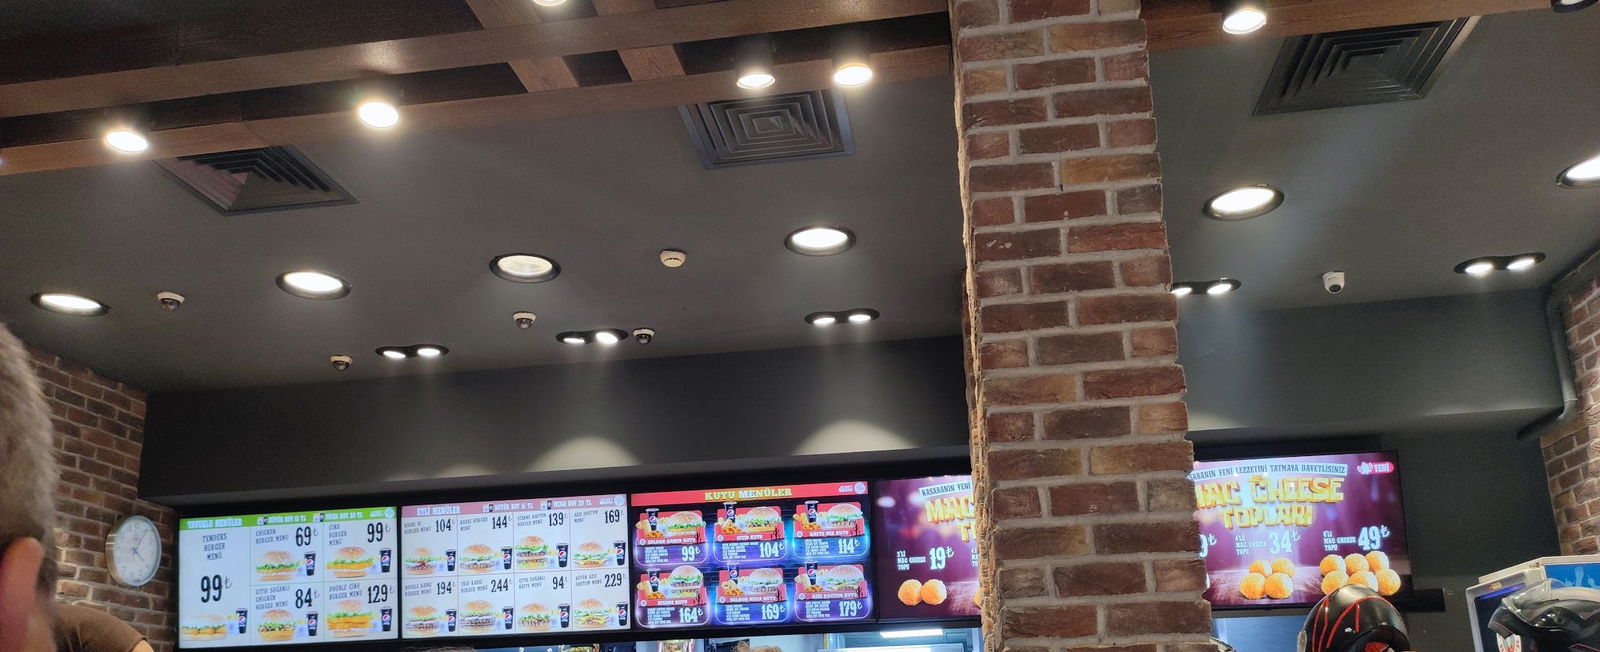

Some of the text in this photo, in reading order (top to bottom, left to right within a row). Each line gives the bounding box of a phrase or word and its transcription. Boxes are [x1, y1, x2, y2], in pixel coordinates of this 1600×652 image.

[1218, 468, 1232, 476] YENİ
[1236, 465, 1267, 474] LEZZETİNİ
[1269, 464, 1298, 472] TATMAYA
[1301, 465, 1345, 474] DAVETLİSİNİZ
[705, 488, 792, 500] KUTU MENÜLER
[921, 484, 955, 496] KASABANIN
[1250, 476, 1344, 503] CHEESE
[1220, 504, 1312, 530] TOPLARI
[202, 533, 227, 542] TENDERS
[204, 543, 225, 551] BURGER
[207, 551, 222, 560] MENÜ
[329, 592, 347, 600] BURGER
